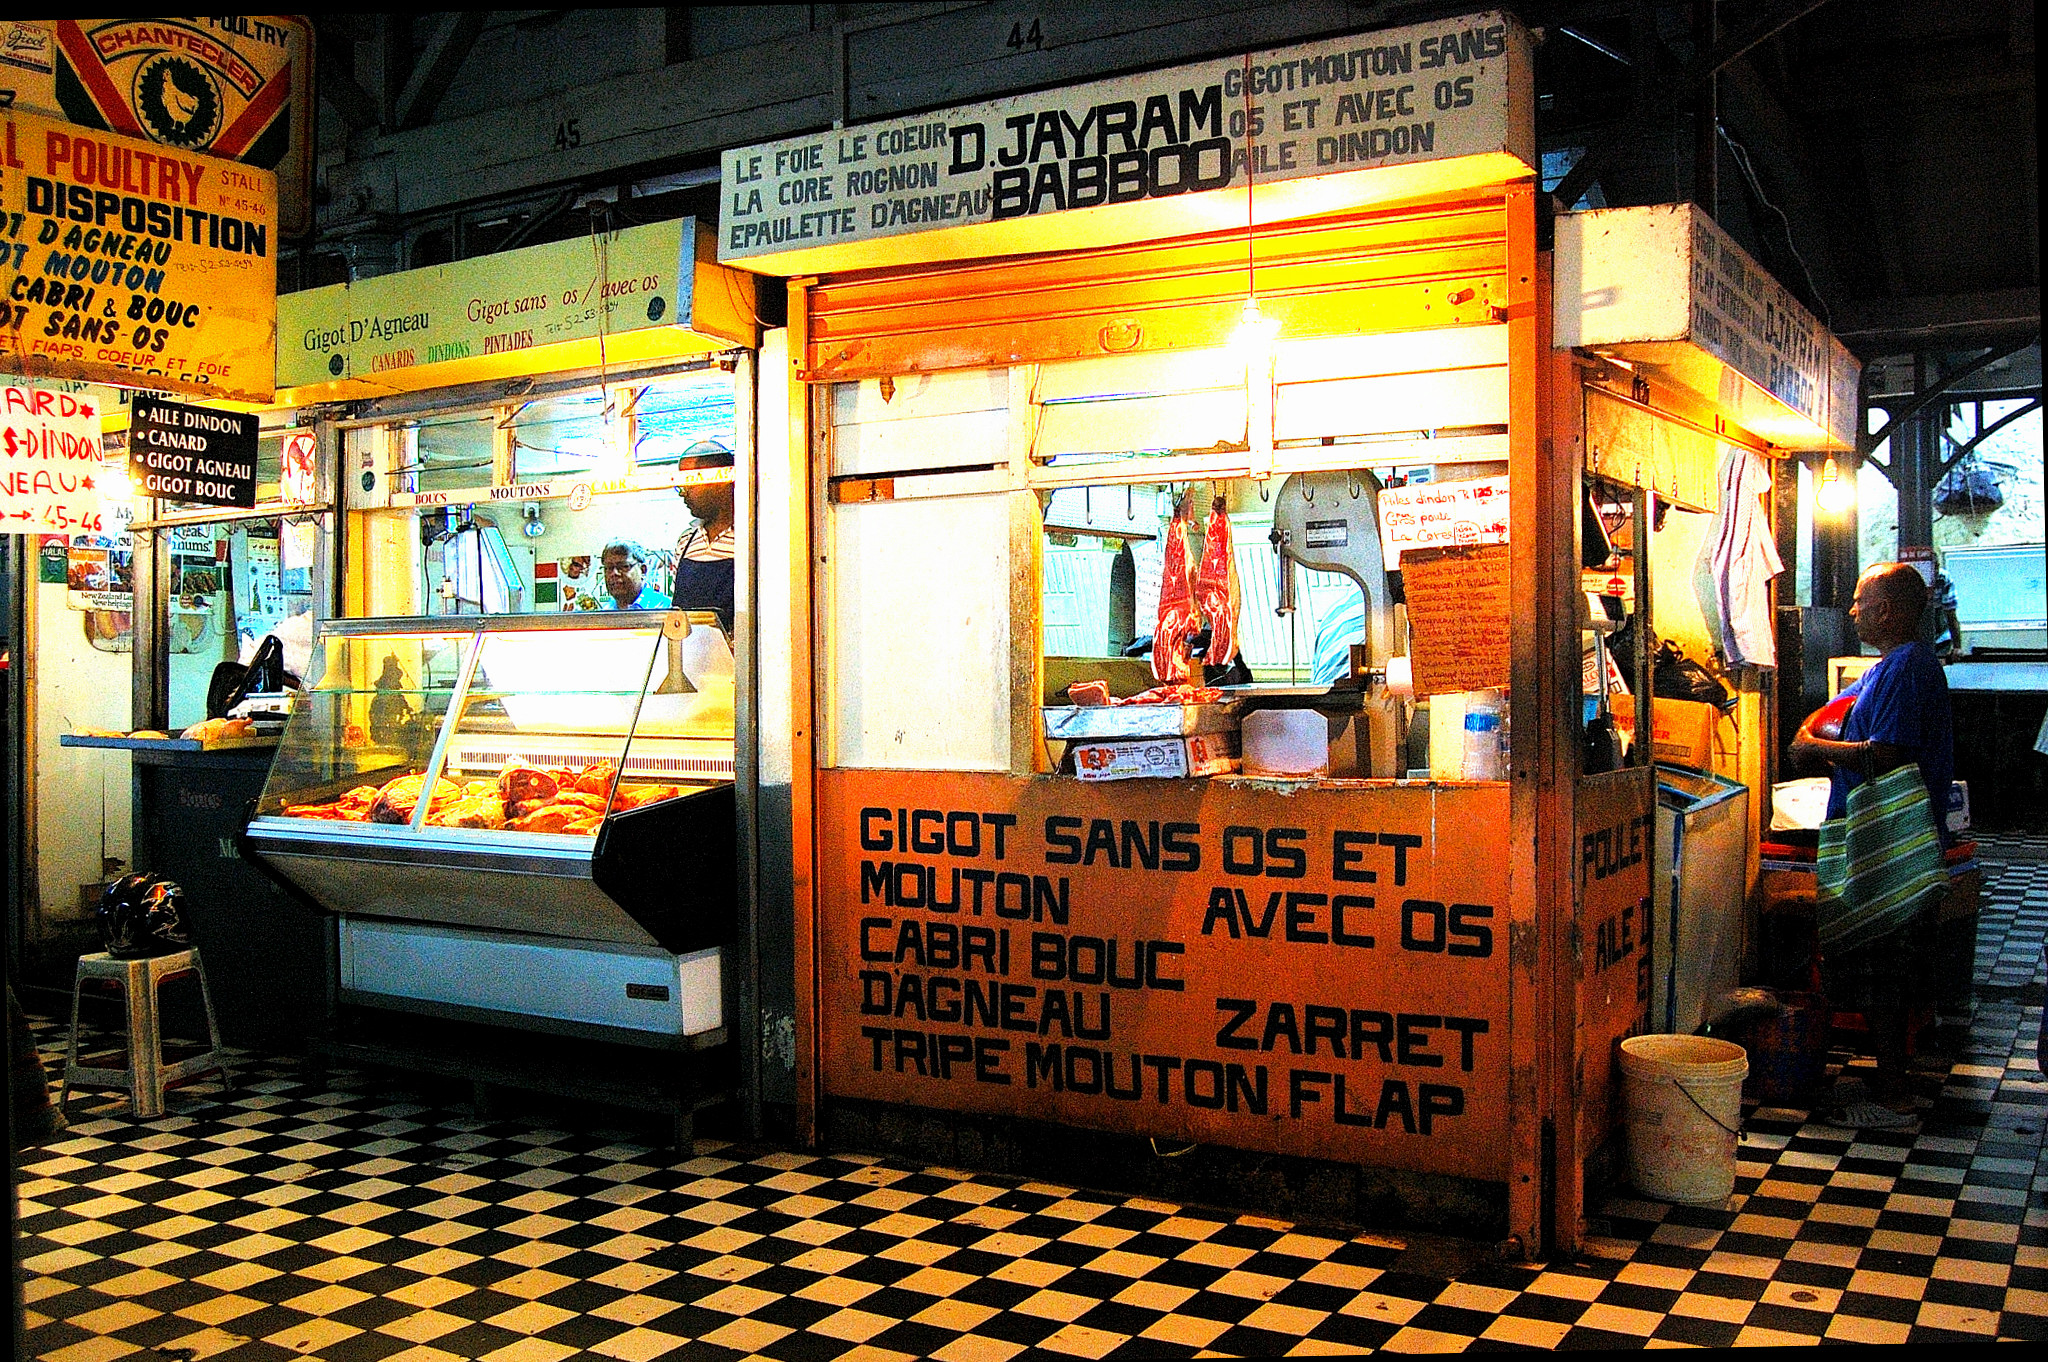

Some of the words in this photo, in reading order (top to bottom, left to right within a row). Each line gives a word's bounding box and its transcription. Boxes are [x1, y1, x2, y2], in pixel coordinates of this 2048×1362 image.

[97, 26, 258, 94] CHANTECLER
[1007, 17, 1044, 50] 44
[1224, 60, 1300, 98] GIGOT
[1300, 43, 1411, 87] MOUTON
[1419, 25, 1506, 69] SANS
[948, 84, 1223, 175] D.JAYRAM
[1228, 109, 1264, 138] OS
[1284, 99, 1320, 131] ET
[1334, 85, 1415, 126] AVEC
[1434, 75, 1475, 111] OS
[555, 118, 580, 150] 45
[735, 156, 762, 184] LE
[775, 144, 823, 176] FOIE
[838, 136, 867, 165] LE
[876, 122, 947, 155] COEUR
[1230, 140, 1297, 178] AILE
[1316, 121, 1434, 166] DINDON
[47, 131, 205, 206] POULTRY
[221, 170, 263, 193] STALL
[733, 190, 763, 216] LA
[779, 175, 833, 205] CORE
[847, 161, 938, 196] ROGNON
[992, 136, 1231, 219] BABBOO
[27, 176, 267, 258] DISPOSITION
[235, 199, 266, 215] 45-46
[730, 207, 856, 249] EPAULETTE
[871, 188, 990, 229] D'AGNEAU
[38, 219, 172, 266] D'AGNEAU
[44, 250, 166, 294] MOUTON
[466, 299, 510, 323] Gigot
[514, 294, 547, 314] sans
[563, 289, 578, 305] os
[601, 278, 637, 298] avec
[642, 274, 658, 291] os
[10, 275, 95, 313] CABRI
[103, 298, 117, 317] &
[127, 294, 200, 328] BOUC
[304, 326, 346, 353] Gigot
[350, 314, 429, 344] D'Agneau
[372, 348, 414, 373] CANARDS
[428, 339, 470, 364] DINDONS
[484, 329, 533, 355] PINTADES
[98, 349, 155, 367] COEUR
[167, 358, 187, 370] ET
[198, 362, 231, 377] FOIE
[149, 407, 180, 428] AILE
[184, 410, 242, 435] DINDON
[149, 429, 207, 452] CANARD
[147, 452, 193, 473] GIGOT
[196, 459, 250, 480] AGNEAU
[147, 474, 192, 494] GIGOT
[196, 478, 236, 500] BOUC
[415, 493, 447, 505] BOUCS
[490, 484, 550, 500] MOUTONS
[1416, 490, 1455, 504] dindon
[860, 807, 1017, 860] GIGOT
[1045, 815, 1200, 872] SANS
[1222, 826, 1307, 879] OS
[1332, 830, 1422, 886] ET
[860, 860, 1069, 925] MOUTON
[1201, 886, 1375, 948] AVEC
[1401, 899, 1494, 958] OS
[859, 917, 1010, 976] CABRI
[1031, 931, 1185, 991] BOUC
[1595, 906, 1634, 974] AILE
[1215, 997, 1489, 1072] ZARRET
[861, 1026, 1011, 1085] TRIPE
[1025, 1042, 1268, 1115] MOUTON
[1290, 1068, 1465, 1136] FLAP
